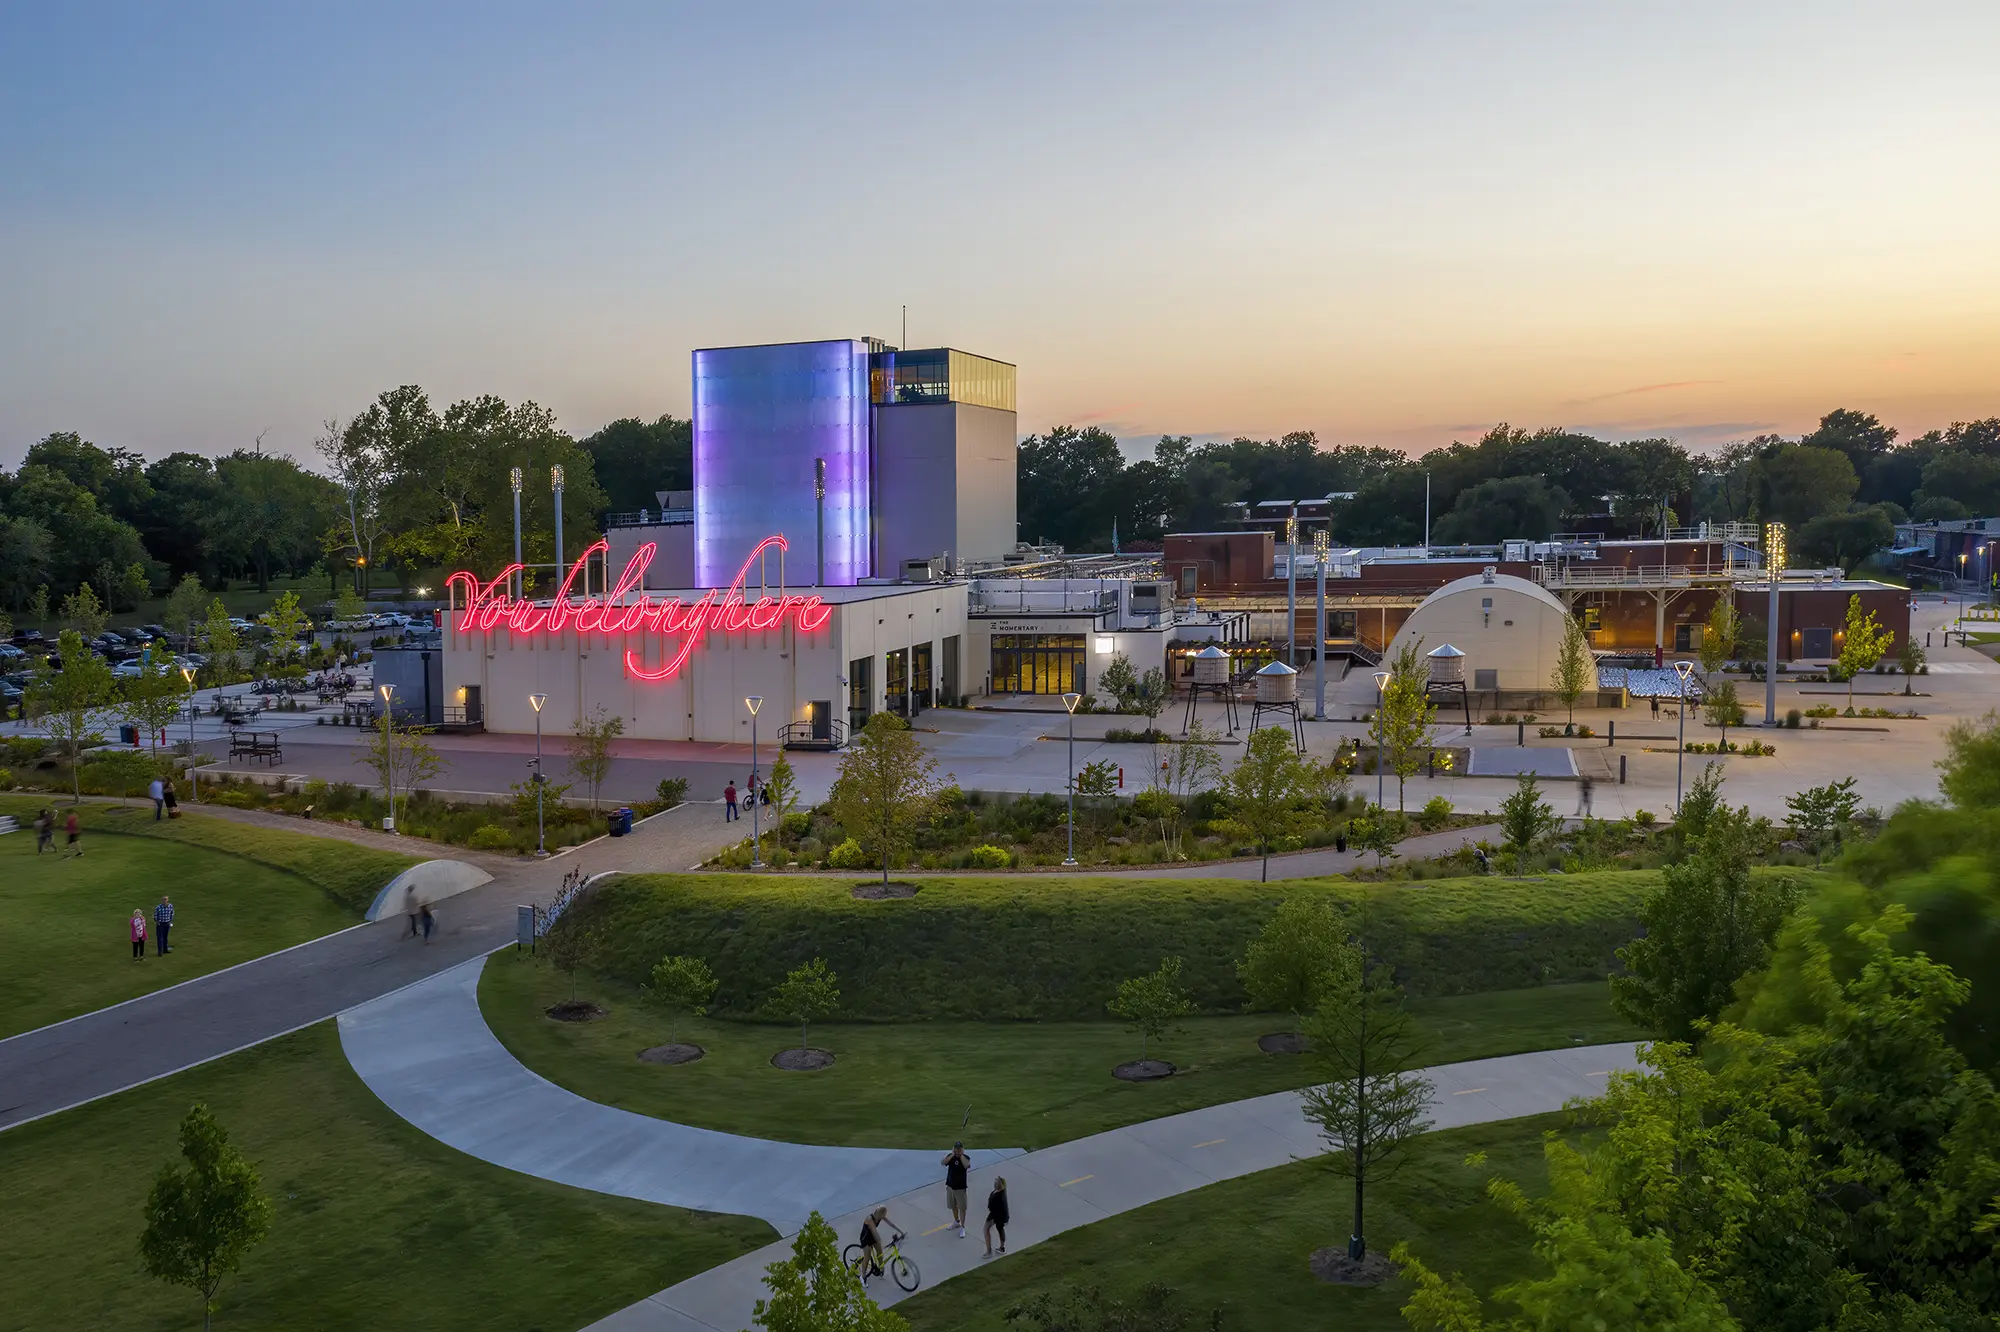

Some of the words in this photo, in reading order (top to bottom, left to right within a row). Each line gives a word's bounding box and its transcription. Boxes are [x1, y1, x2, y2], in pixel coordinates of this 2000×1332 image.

[445, 563, 547, 632] You
[547, 540, 718, 680] belong
[711, 535, 833, 631] here
